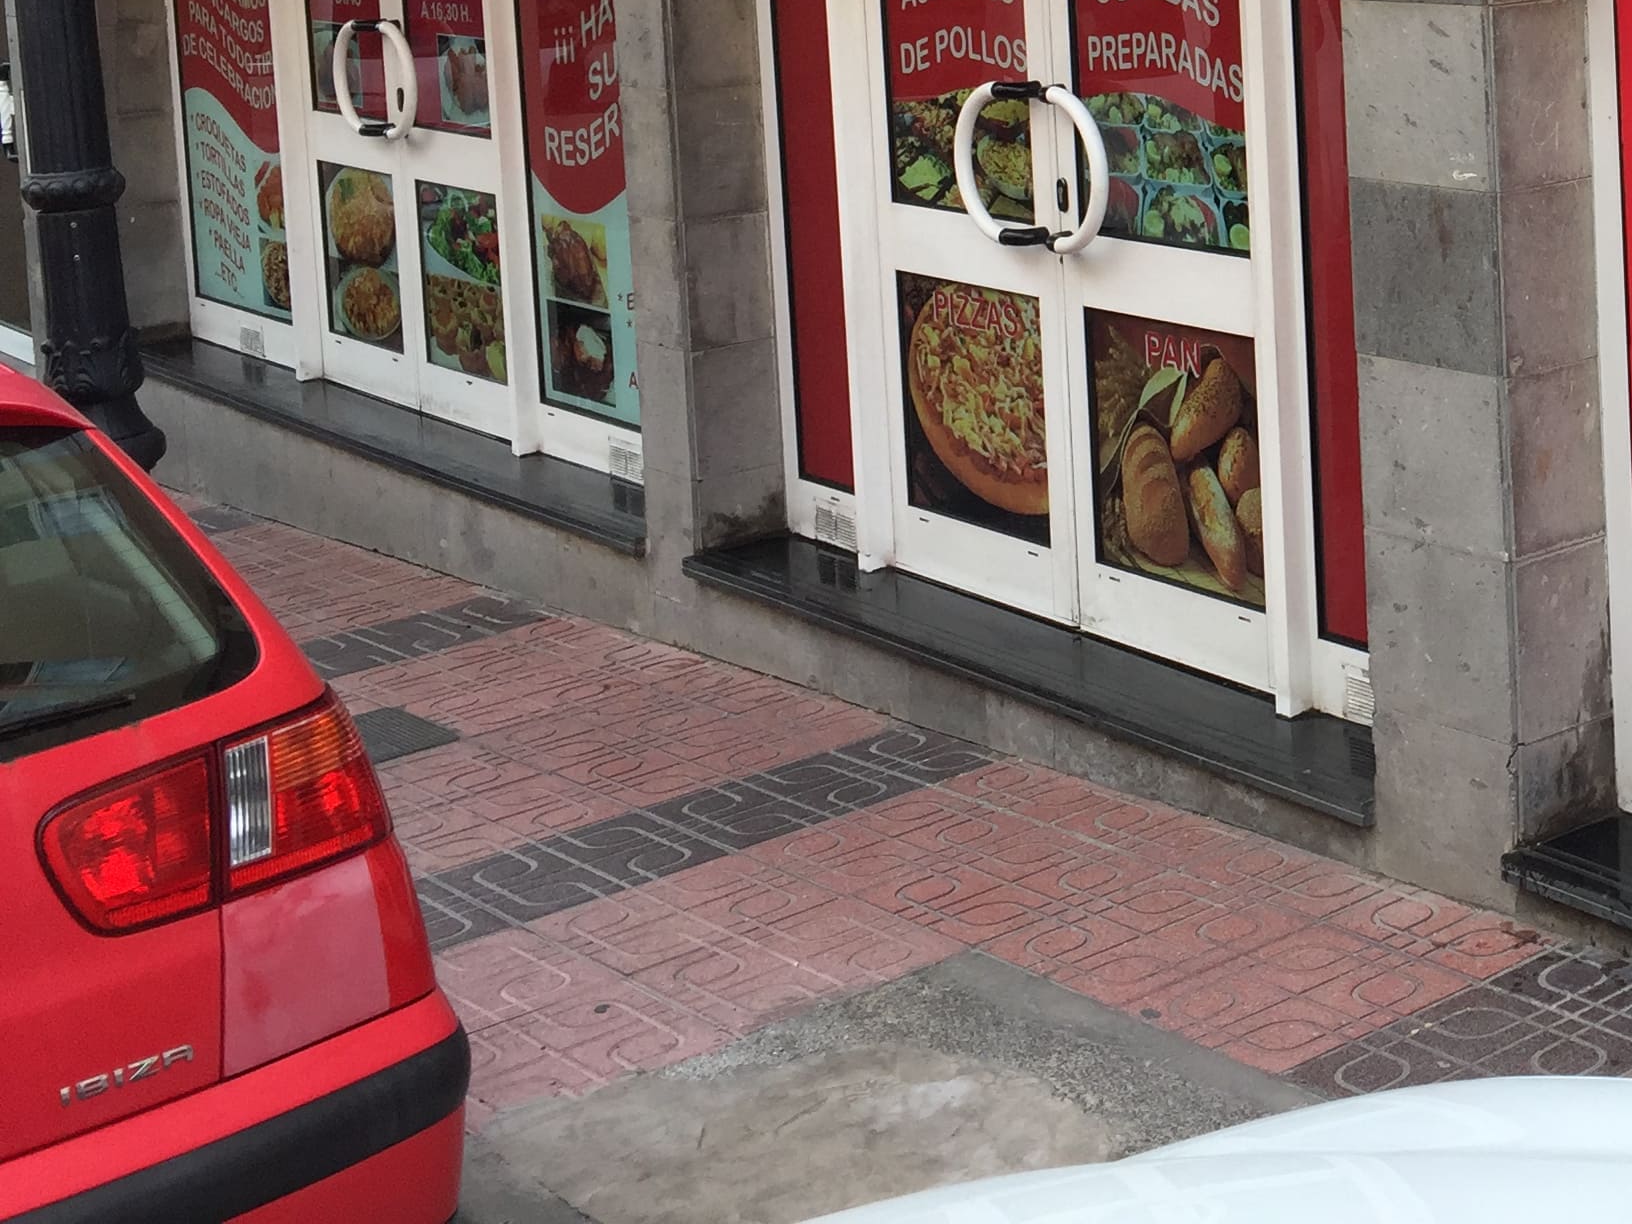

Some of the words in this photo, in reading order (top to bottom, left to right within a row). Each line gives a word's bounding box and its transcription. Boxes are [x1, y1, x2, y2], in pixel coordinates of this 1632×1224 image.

[420, 0, 430, 21] A
[182, 33, 198, 56] DE
[188, 0, 219, 41] PARA
[218, 23, 253, 75] TODO
[900, 38, 930, 75] DE
[935, 25, 1027, 73] POLLOS
[588, 40, 618, 101] SU
[1087, 31, 1243, 103] PREPARADAS
[200, 141, 246, 198] TORTILLAS
[201, 169, 250, 226] ESTOFADOS
[213, 229, 246, 275] PAELLA
[932, 289, 1020, 339] PIZZAS
[1144, 331, 1201, 378] PAN
[59, 1043, 195, 1106] IBIZA
